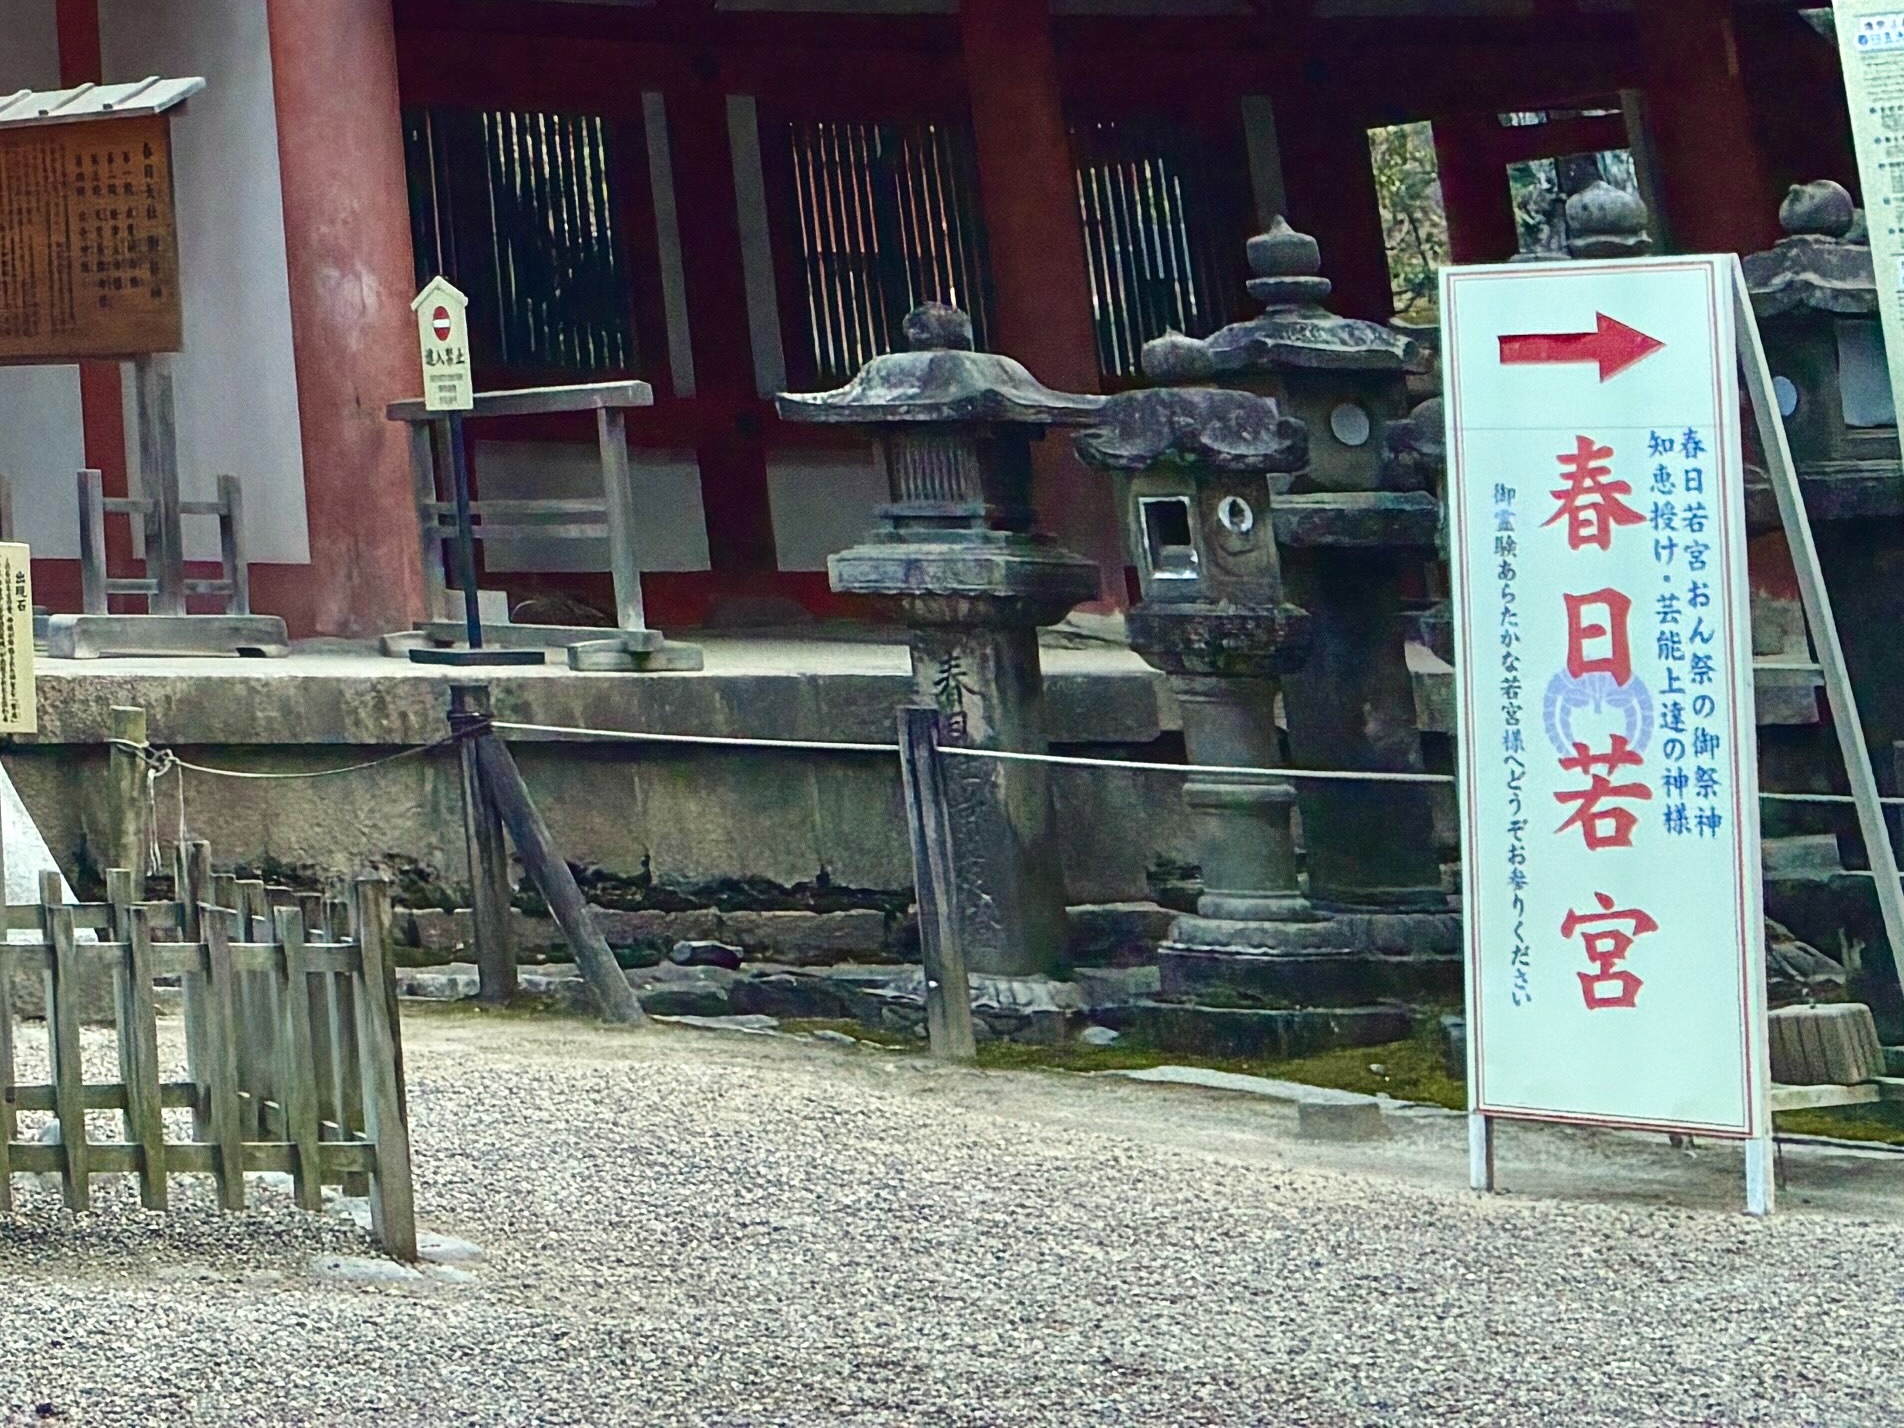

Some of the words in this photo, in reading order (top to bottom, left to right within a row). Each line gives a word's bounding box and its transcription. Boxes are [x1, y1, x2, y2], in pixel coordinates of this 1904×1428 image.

[1539, 434, 1659, 1011] 春日若宮
[1679, 426, 1723, 839] 春日若宮おん祭の御祭神
